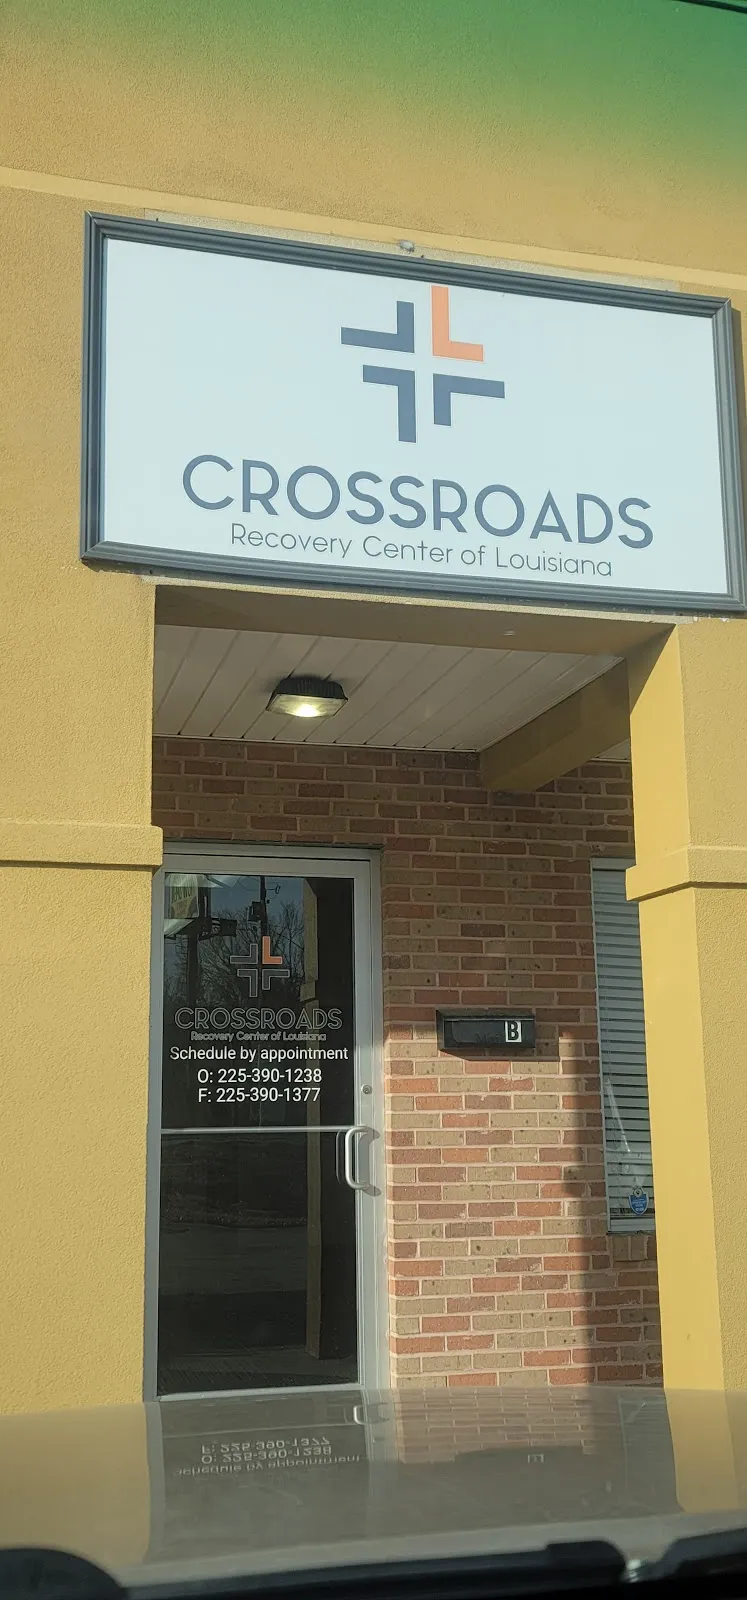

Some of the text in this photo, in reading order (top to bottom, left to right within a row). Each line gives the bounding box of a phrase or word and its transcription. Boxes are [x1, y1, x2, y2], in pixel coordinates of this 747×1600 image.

[182, 454, 654, 549] CROSSROADS
[231, 522, 612, 577] Recovery Center of Louisiana
[174, 1007, 342, 1029] CROSSROADS
[191, 1031, 326, 1042] Recovery Center of Louisiana
[507, 1020, 519, 1041] B
[170, 1046, 348, 1062] Schedule by appointment
[197, 1068, 322, 1083] O: 225-390-1238
[198, 1087, 321, 1102] F: 225-390-1377
